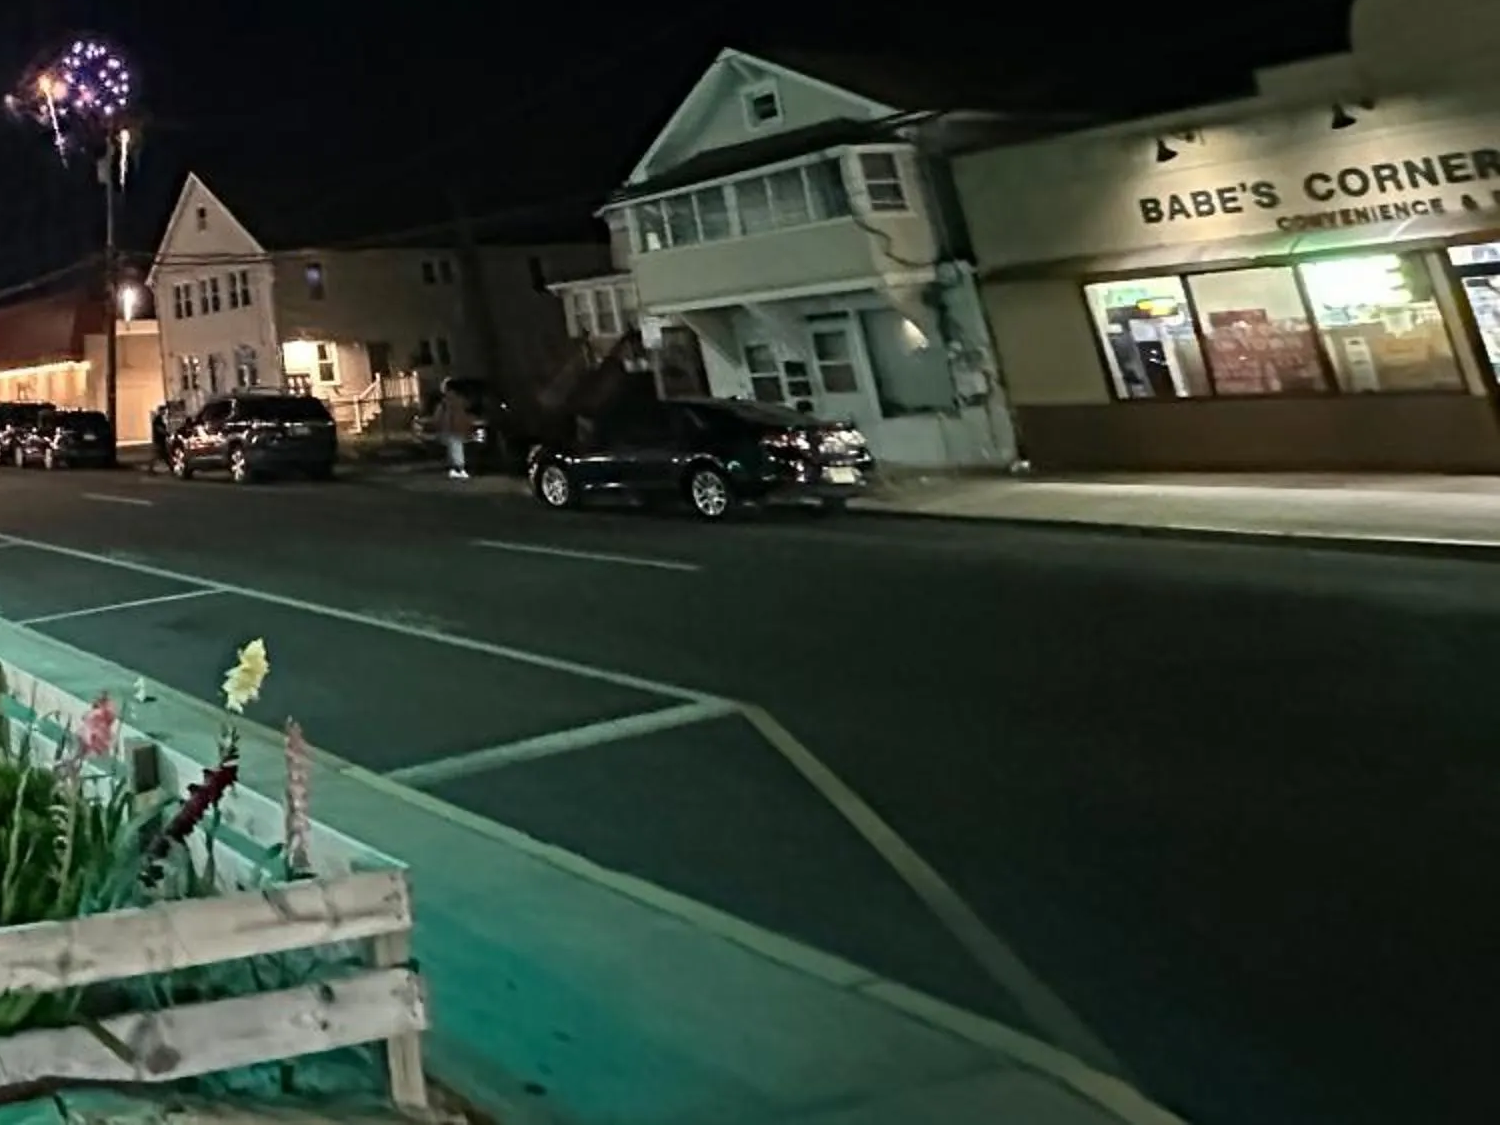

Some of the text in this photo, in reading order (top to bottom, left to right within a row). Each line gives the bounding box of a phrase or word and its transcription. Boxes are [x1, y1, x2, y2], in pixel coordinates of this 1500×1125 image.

[1138, 148, 1500, 224] BABE'S CORNER
[1276, 198, 1446, 232] CONVENIENCE
